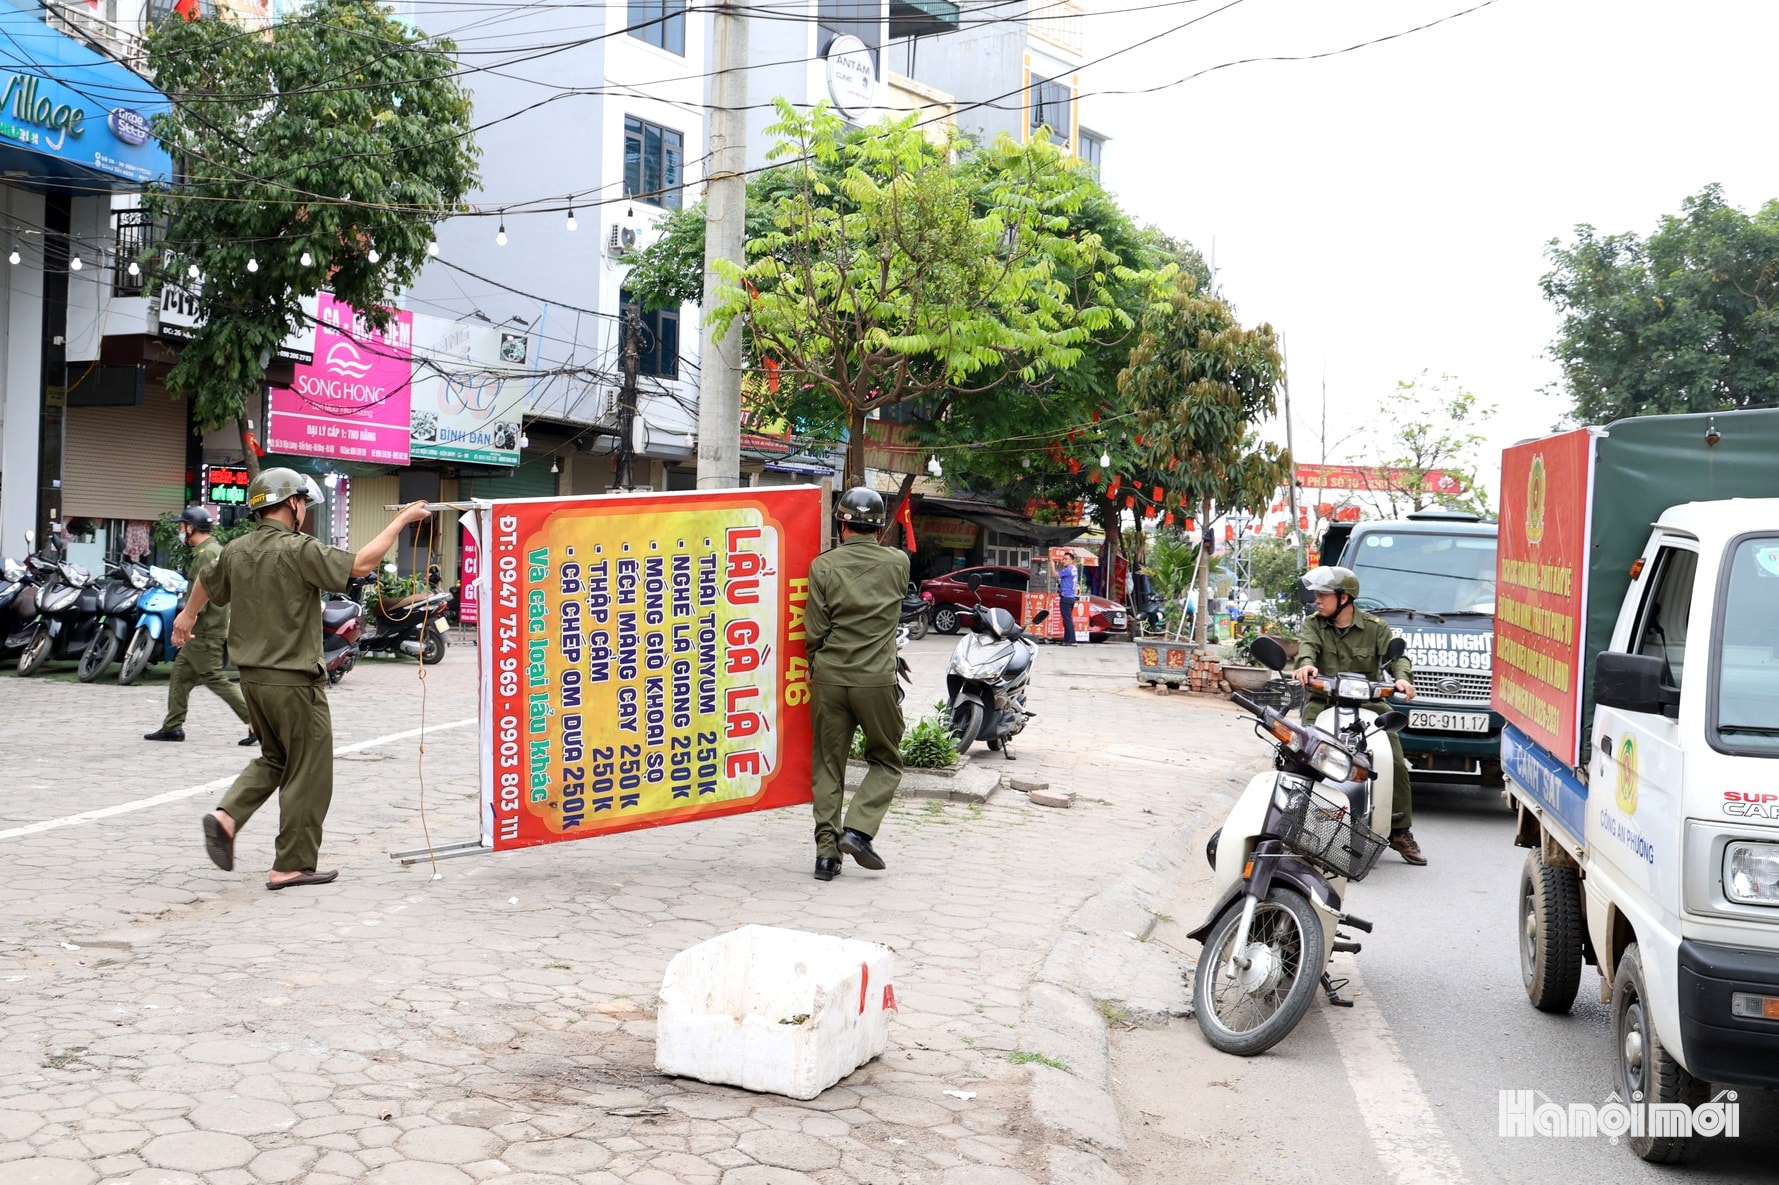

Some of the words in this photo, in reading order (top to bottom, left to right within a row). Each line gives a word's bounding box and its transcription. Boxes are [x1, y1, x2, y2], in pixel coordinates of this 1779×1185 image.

[499, 515, 517, 551] ĐT:
[499, 556, 518, 608] 0947
[529, 547, 549, 583] Và
[561, 562, 587, 594] CÁ
[617, 559, 641, 605] ẾCH
[673, 556, 696, 617] NGHÉ
[700, 553, 721, 607] THÁI
[727, 528, 777, 606] LẨU
[529, 590, 549, 633] các
[587, 560, 612, 624] THẬP
[645, 557, 669, 625] MÓNG
[499, 614, 517, 653] 734
[561, 601, 587, 663] CHÉP
[618, 612, 641, 680] MĂNG
[645, 632, 669, 670] GIÒ
[673, 624, 696, 653] LÁ
[726, 620, 771, 674] GÀ
[1391, 628, 1447, 650] HÁNH
[500, 657, 518, 697] 969
[526, 639, 549, 687] loại
[590, 630, 618, 683] CẨM
[700, 613, 717, 714] TOMYUM
[561, 669, 582, 708] OM
[673, 660, 692, 728] GIANG
[785, 656, 811, 707] 46
[529, 692, 555, 734] lẩu
[619, 686, 639, 733] CAY
[645, 677, 665, 746] KHOAI
[726, 687, 770, 739] LÁ
[1411, 713, 1487, 731] 29C-911.17
[500, 715, 519, 768] 0903
[562, 713, 585, 763] DƯA
[530, 740, 552, 802] khác
[643, 753, 665, 783] SỌ
[726, 750, 770, 779] É
[500, 772, 519, 812] 803
[501, 815, 519, 840] 111
